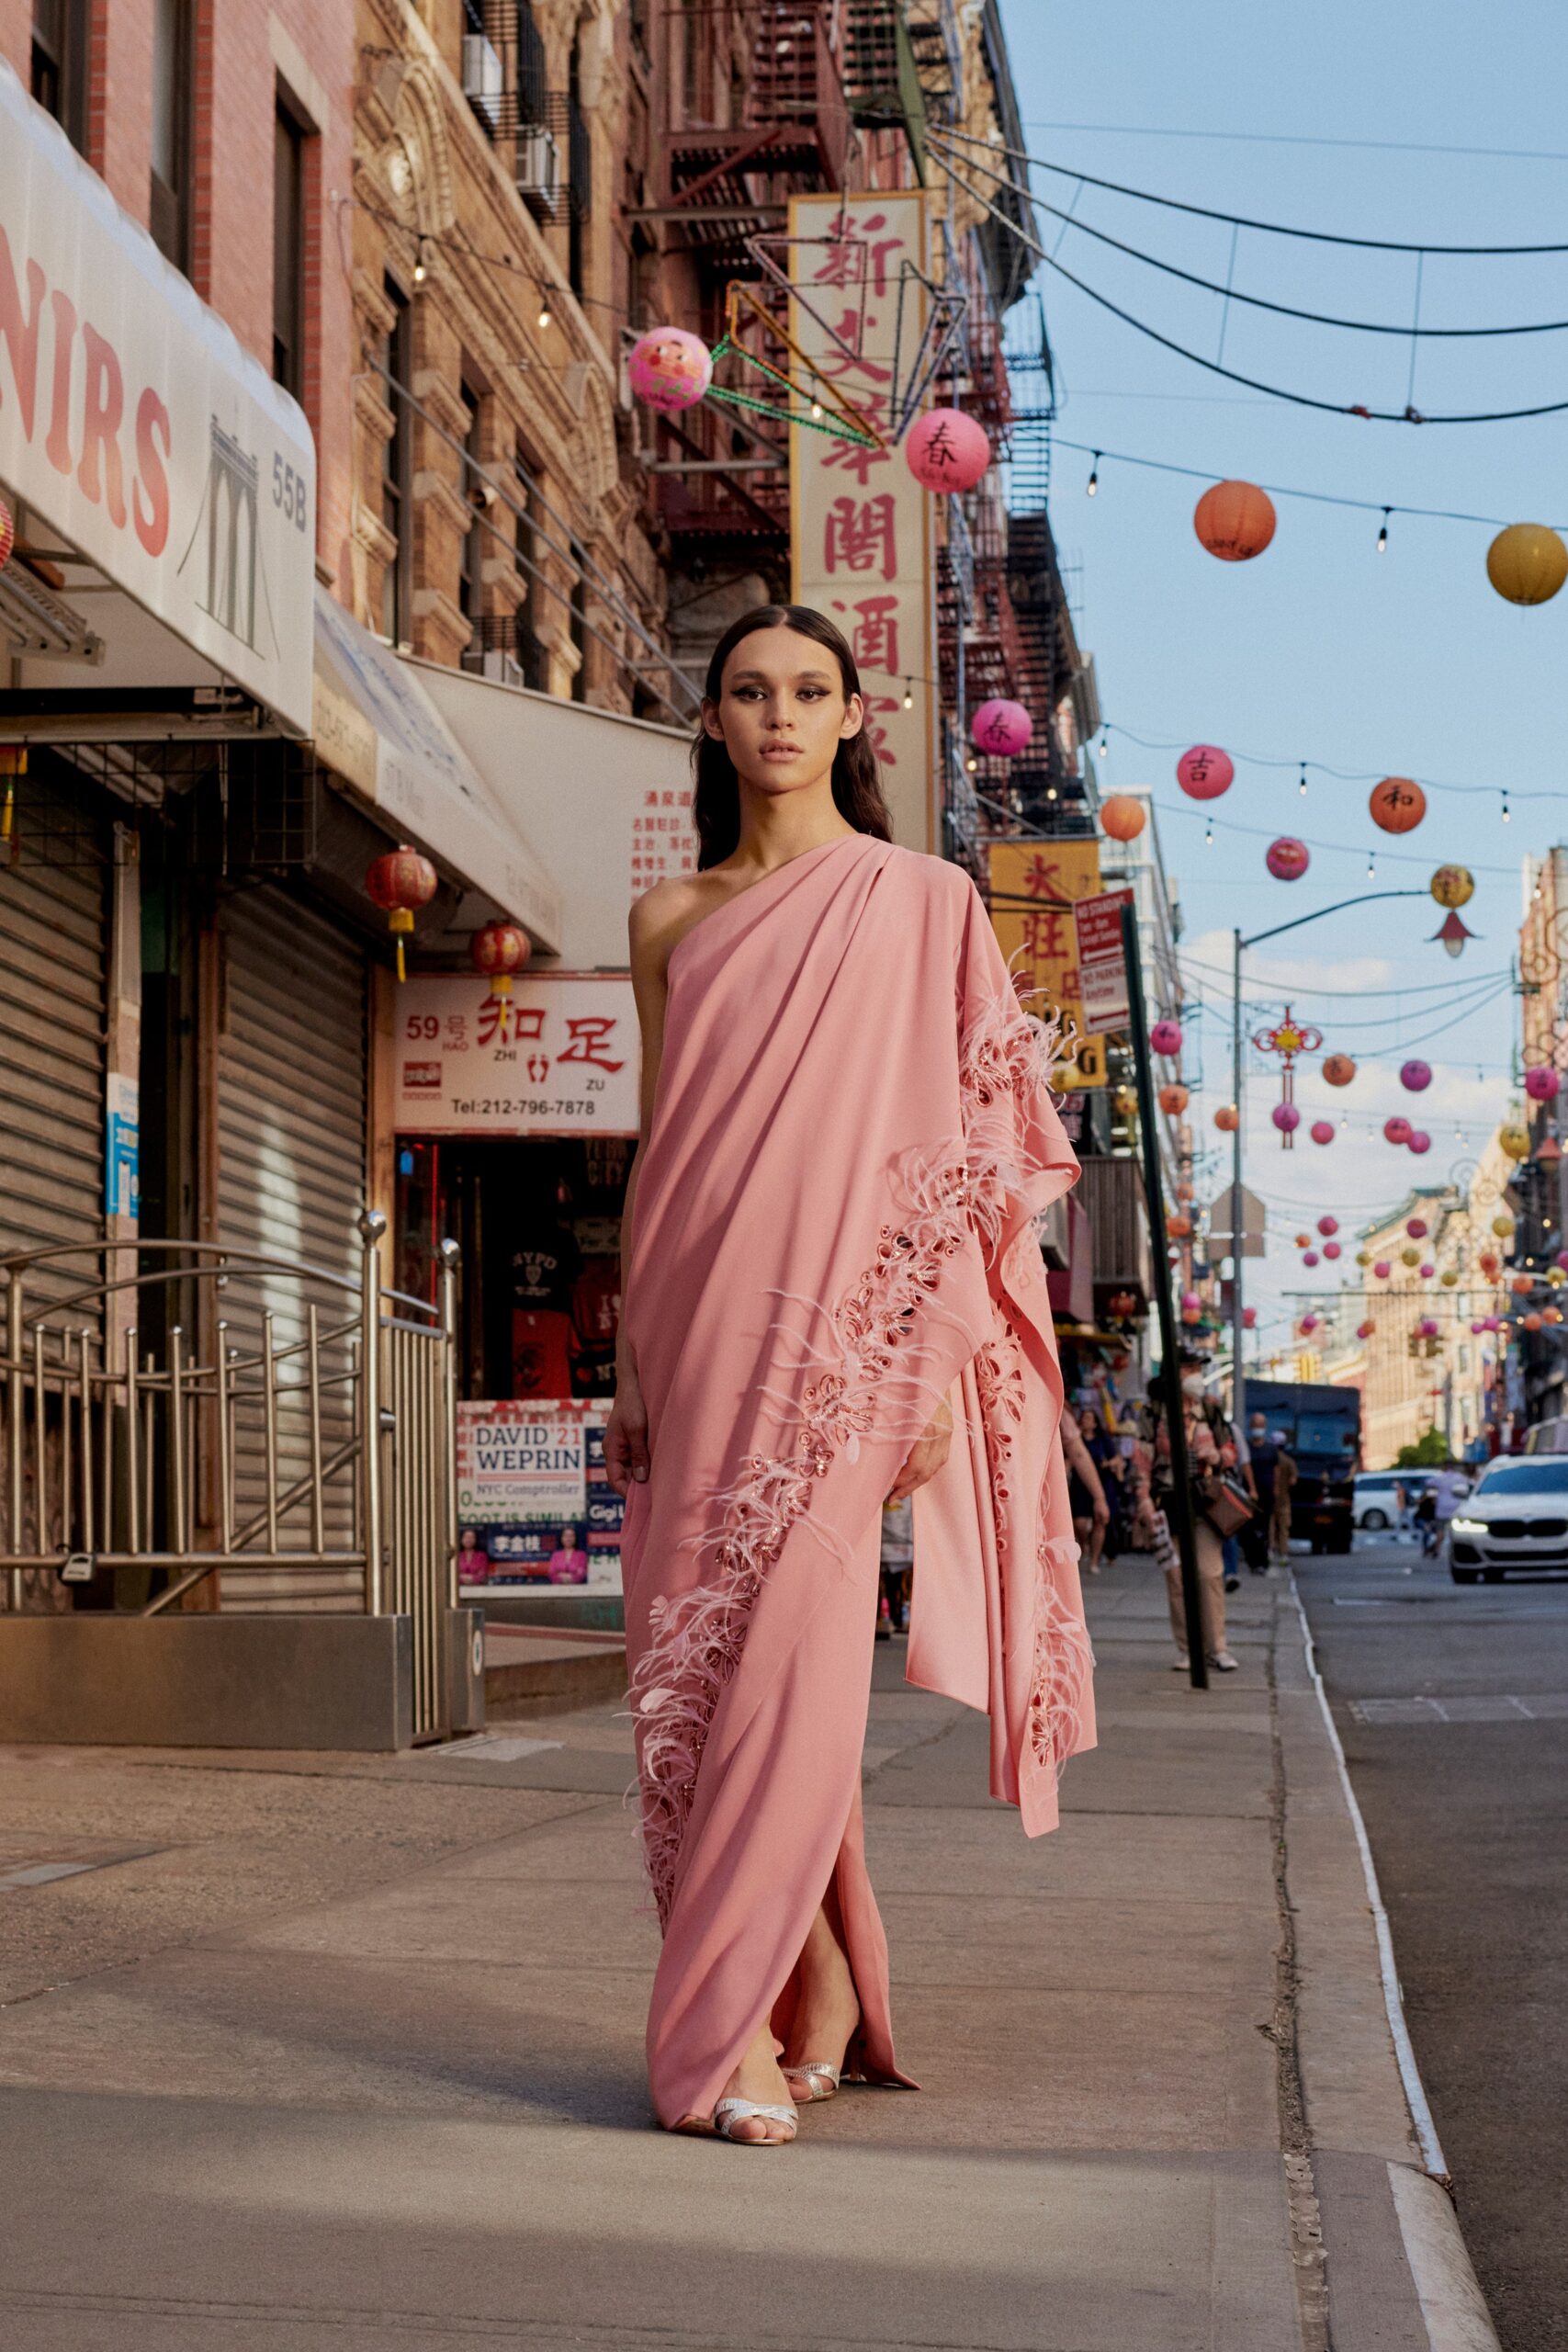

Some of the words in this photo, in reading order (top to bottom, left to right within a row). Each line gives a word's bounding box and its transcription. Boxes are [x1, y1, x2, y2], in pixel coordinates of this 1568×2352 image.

[921, 421, 958, 467] 春
[272, 451, 307, 533] 55B
[1188, 751, 1215, 782] 吉
[1382, 786, 1414, 810] 和
[407, 1015, 439, 1040] 59
[477, 992, 625, 1073] 知足
[442, 1042, 468, 1052] HAO
[493, 1050, 516, 1061] ZHI
[586, 1080, 605, 1091] ZU
[452, 1099, 595, 1115] Tel:212-796-7878
[512, 1251, 558, 1271] NYPD
[477, 1427, 548, 1445] DAVID
[477, 1449, 581, 1470] WEPRIN
[477, 1484, 502, 1495] NYC
[505, 1484, 580, 1497] Comptroller
